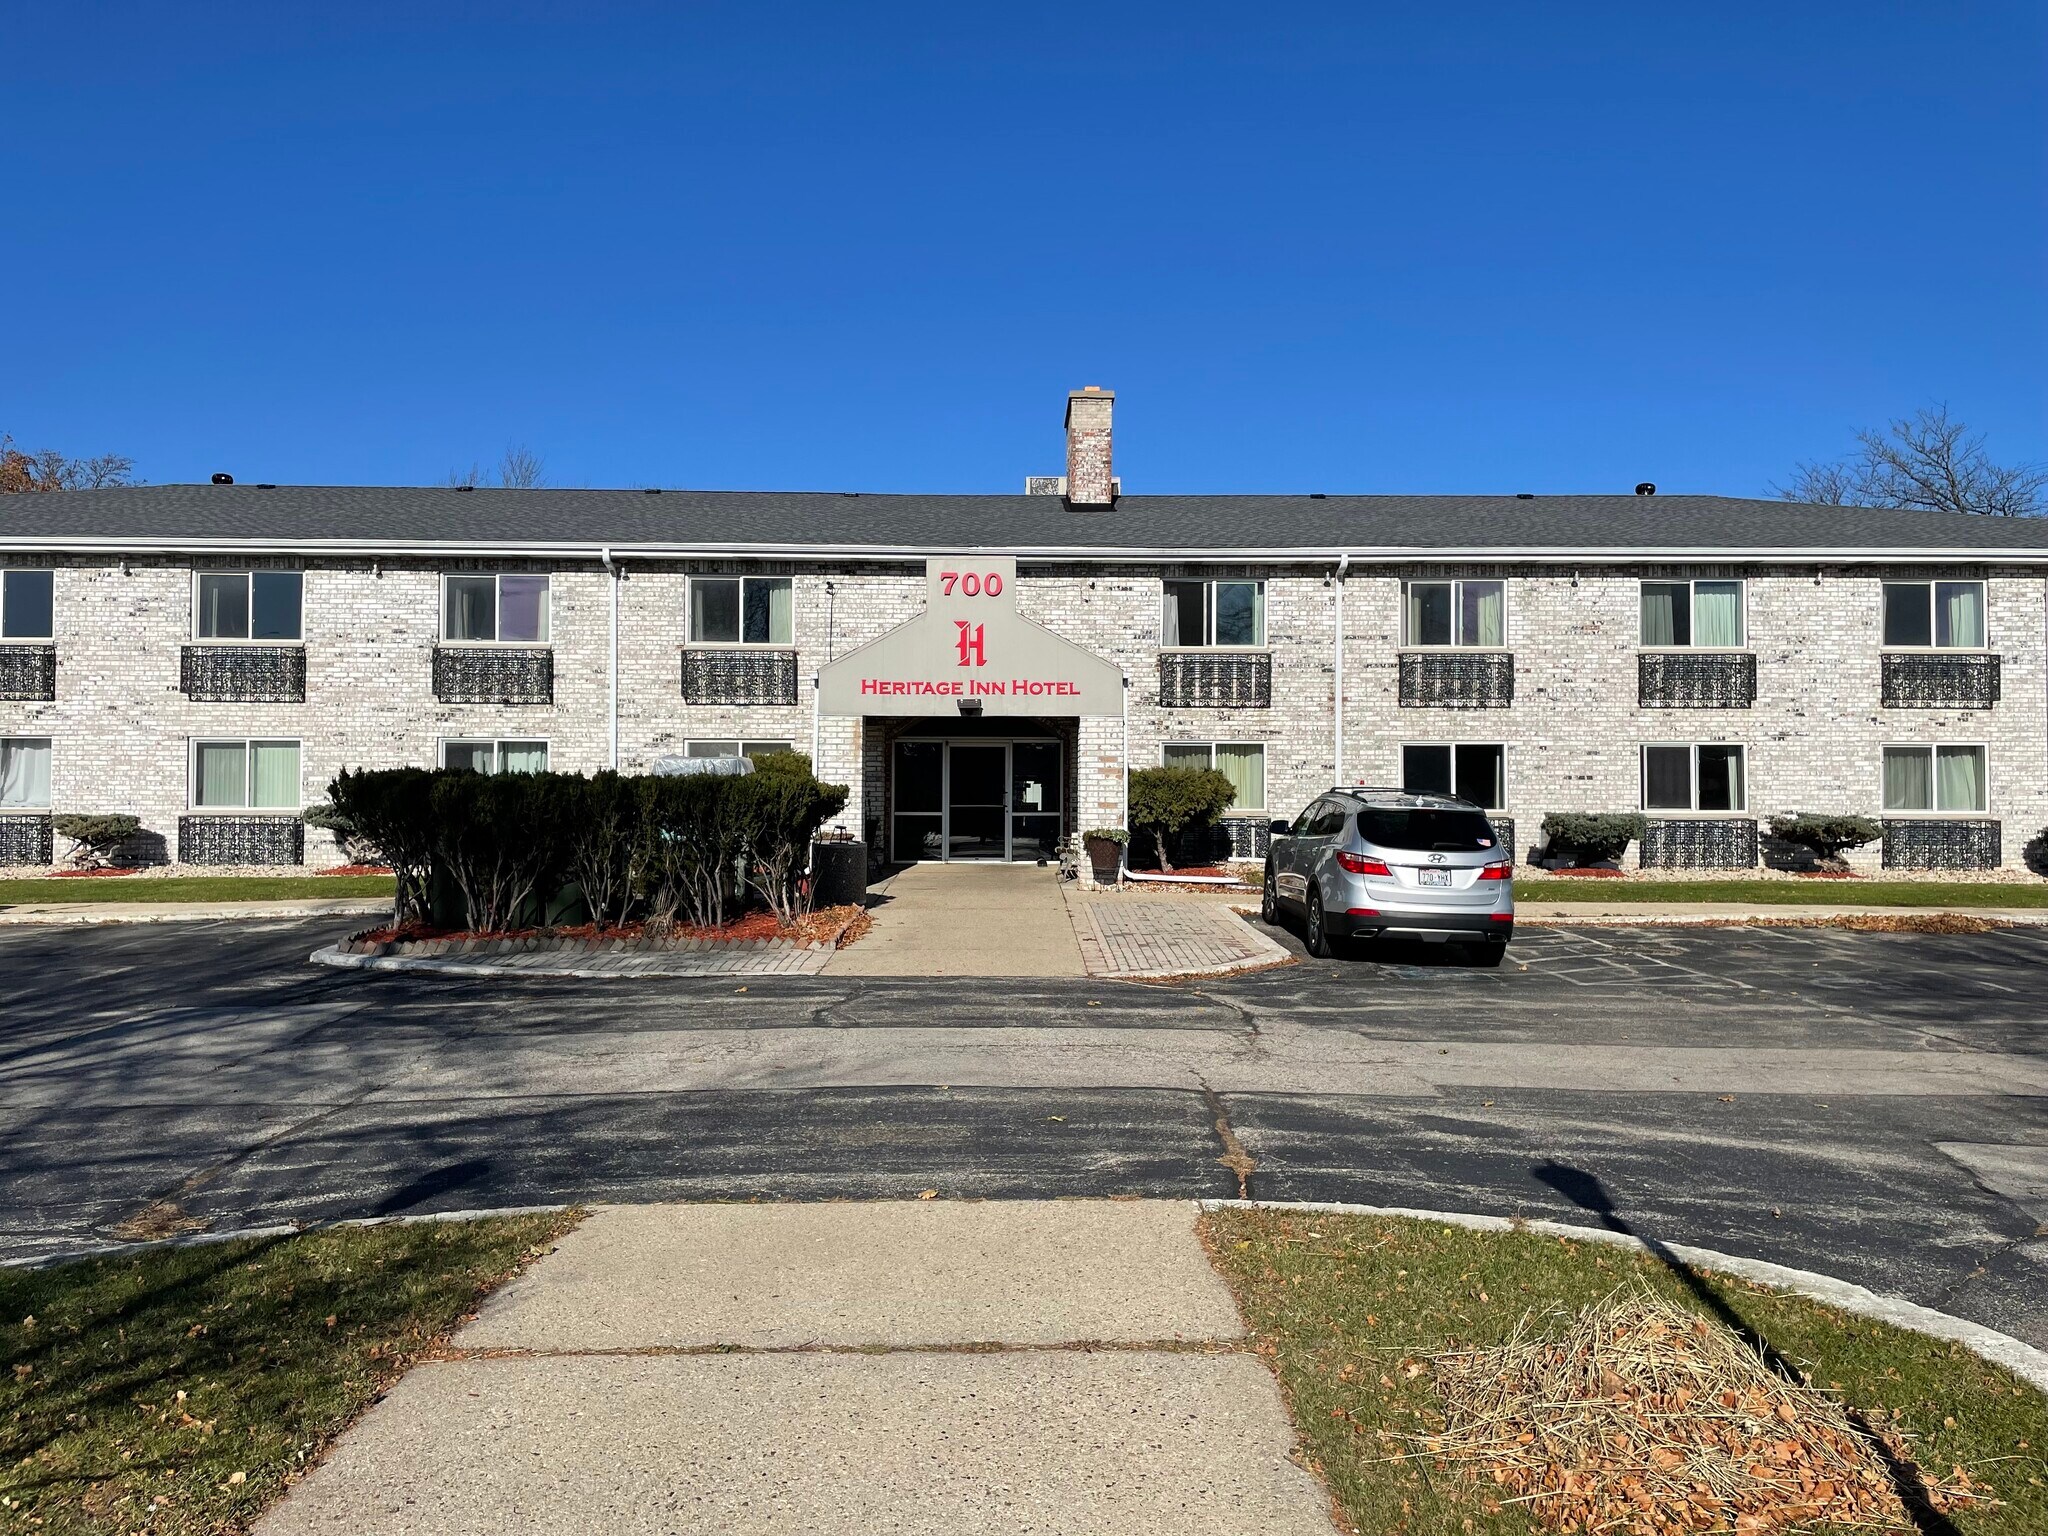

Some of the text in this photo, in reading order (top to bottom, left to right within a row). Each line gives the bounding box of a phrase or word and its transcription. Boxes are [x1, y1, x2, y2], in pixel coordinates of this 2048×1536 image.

[941, 572, 1003, 597] 700
[953, 621, 988, 667] H
[861, 679, 1081, 696] HERITAGE INN HOTEL
